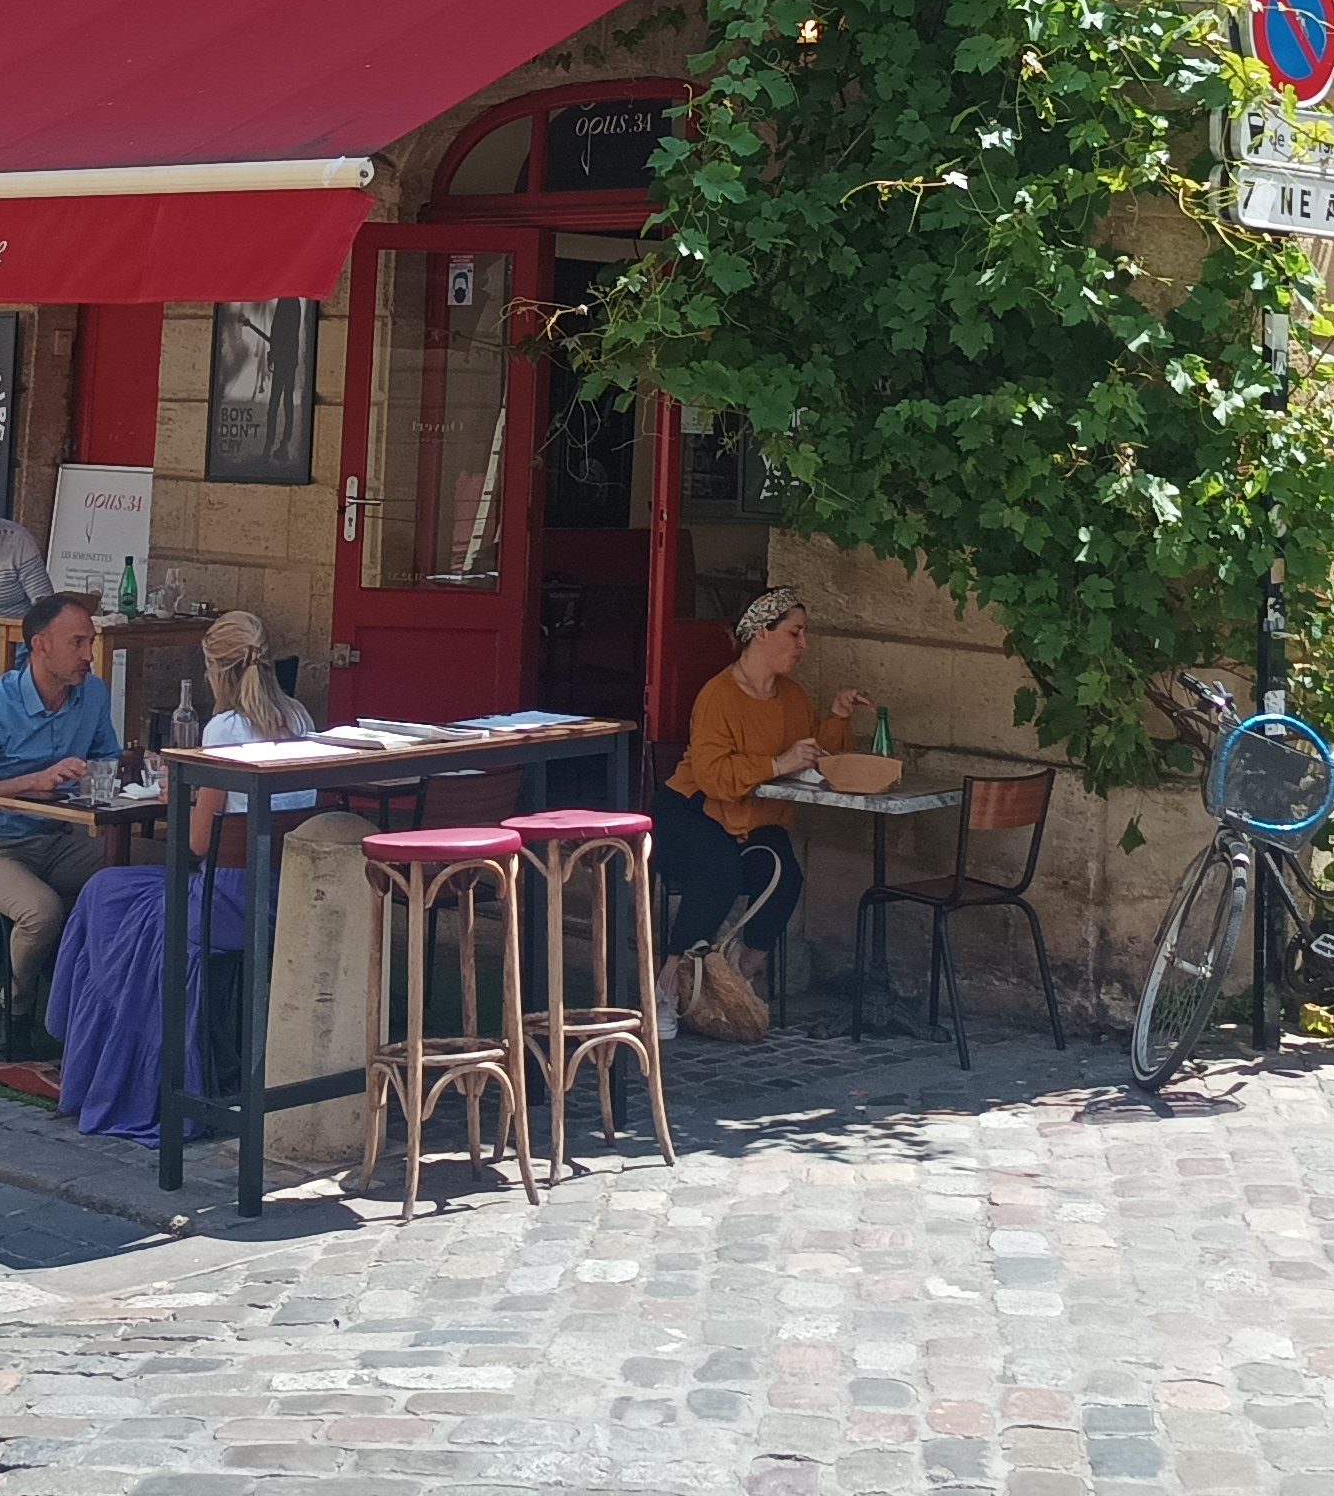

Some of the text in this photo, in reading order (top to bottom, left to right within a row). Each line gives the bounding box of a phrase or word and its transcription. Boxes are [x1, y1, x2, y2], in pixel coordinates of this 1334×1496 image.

[221, 407, 253, 422] BOYS
[220, 424, 261, 438] DON'T
[219, 439, 243, 453] CRY
